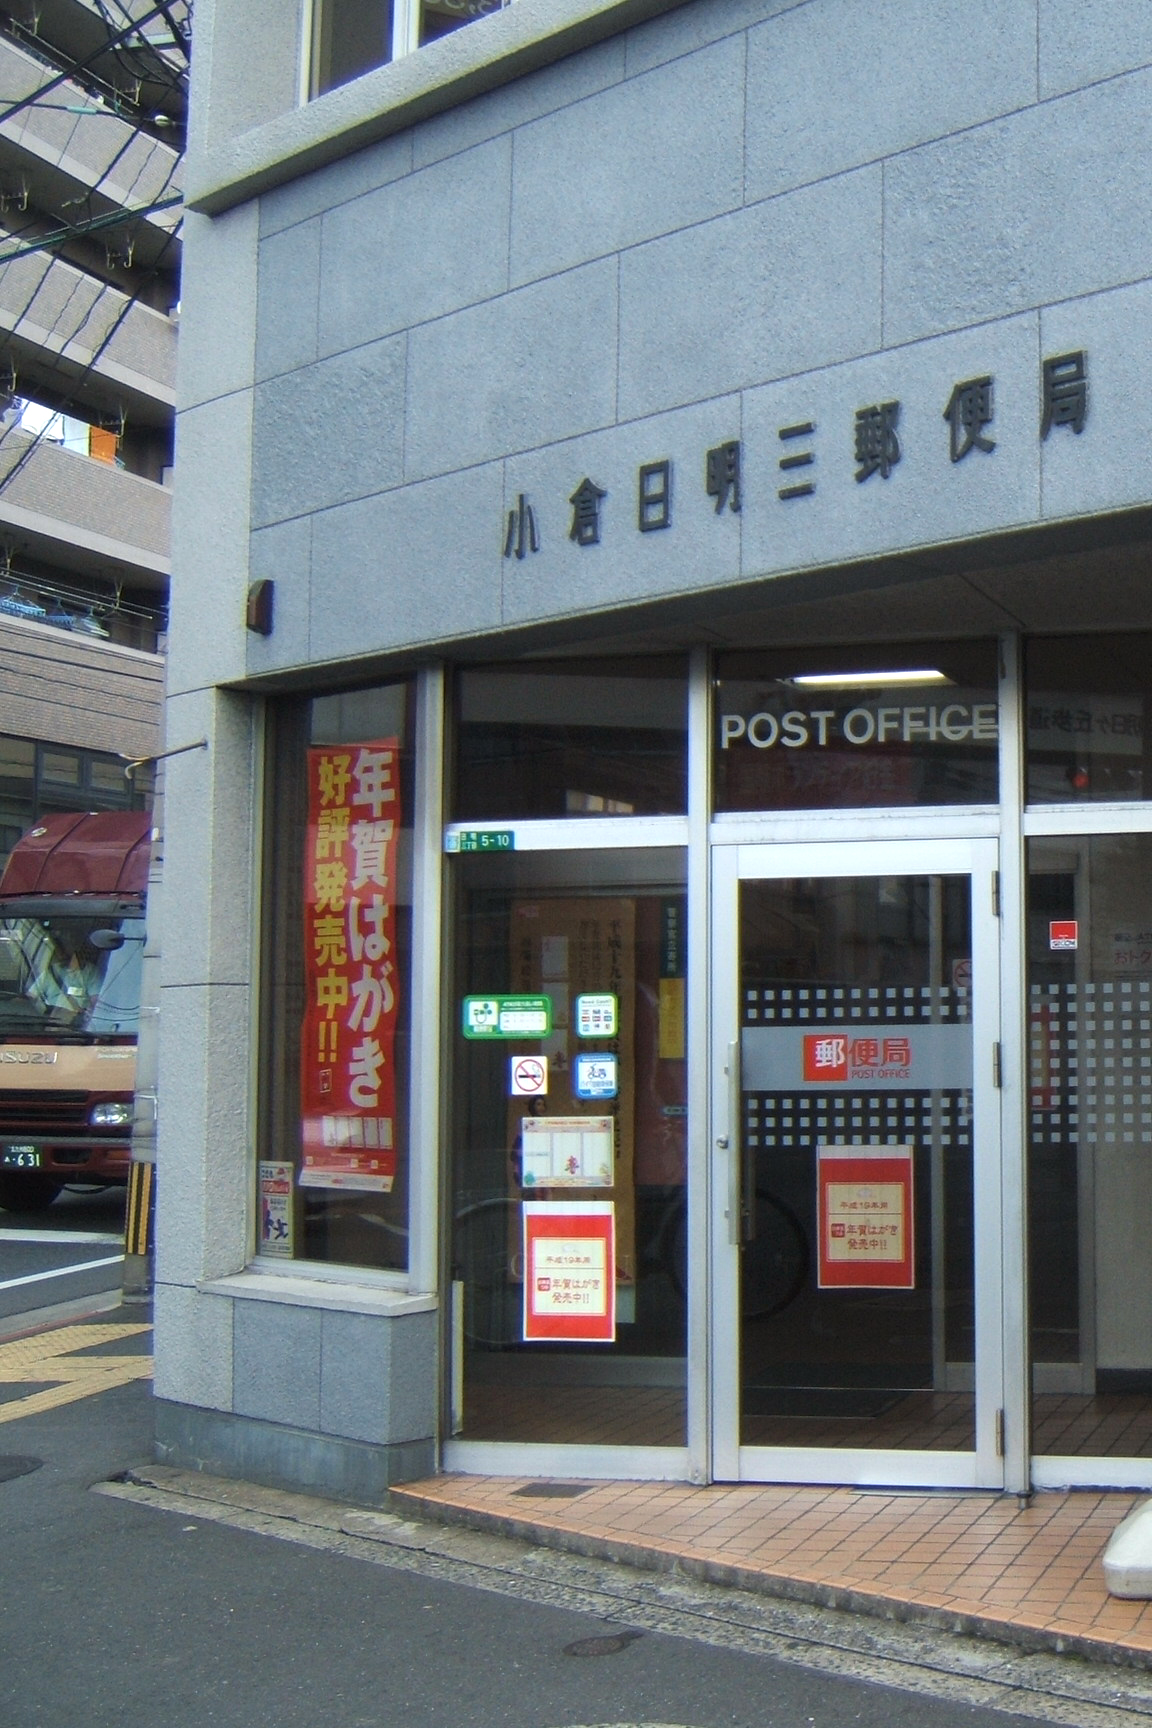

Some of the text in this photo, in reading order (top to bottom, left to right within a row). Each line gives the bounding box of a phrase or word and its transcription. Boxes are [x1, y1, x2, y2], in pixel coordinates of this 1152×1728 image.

[503, 349, 1089, 561] 小倉日明三郵便局
[720, 704, 998, 749] POST OFFICE
[481, 834, 510, 847] 5-10
[312, 754, 353, 1064] 好評発売中!!
[348, 747, 396, 1109] 年賀はがき
[814, 1037, 912, 1068] 郵便局
[851, 1068, 911, 1079] POST OFFICE
